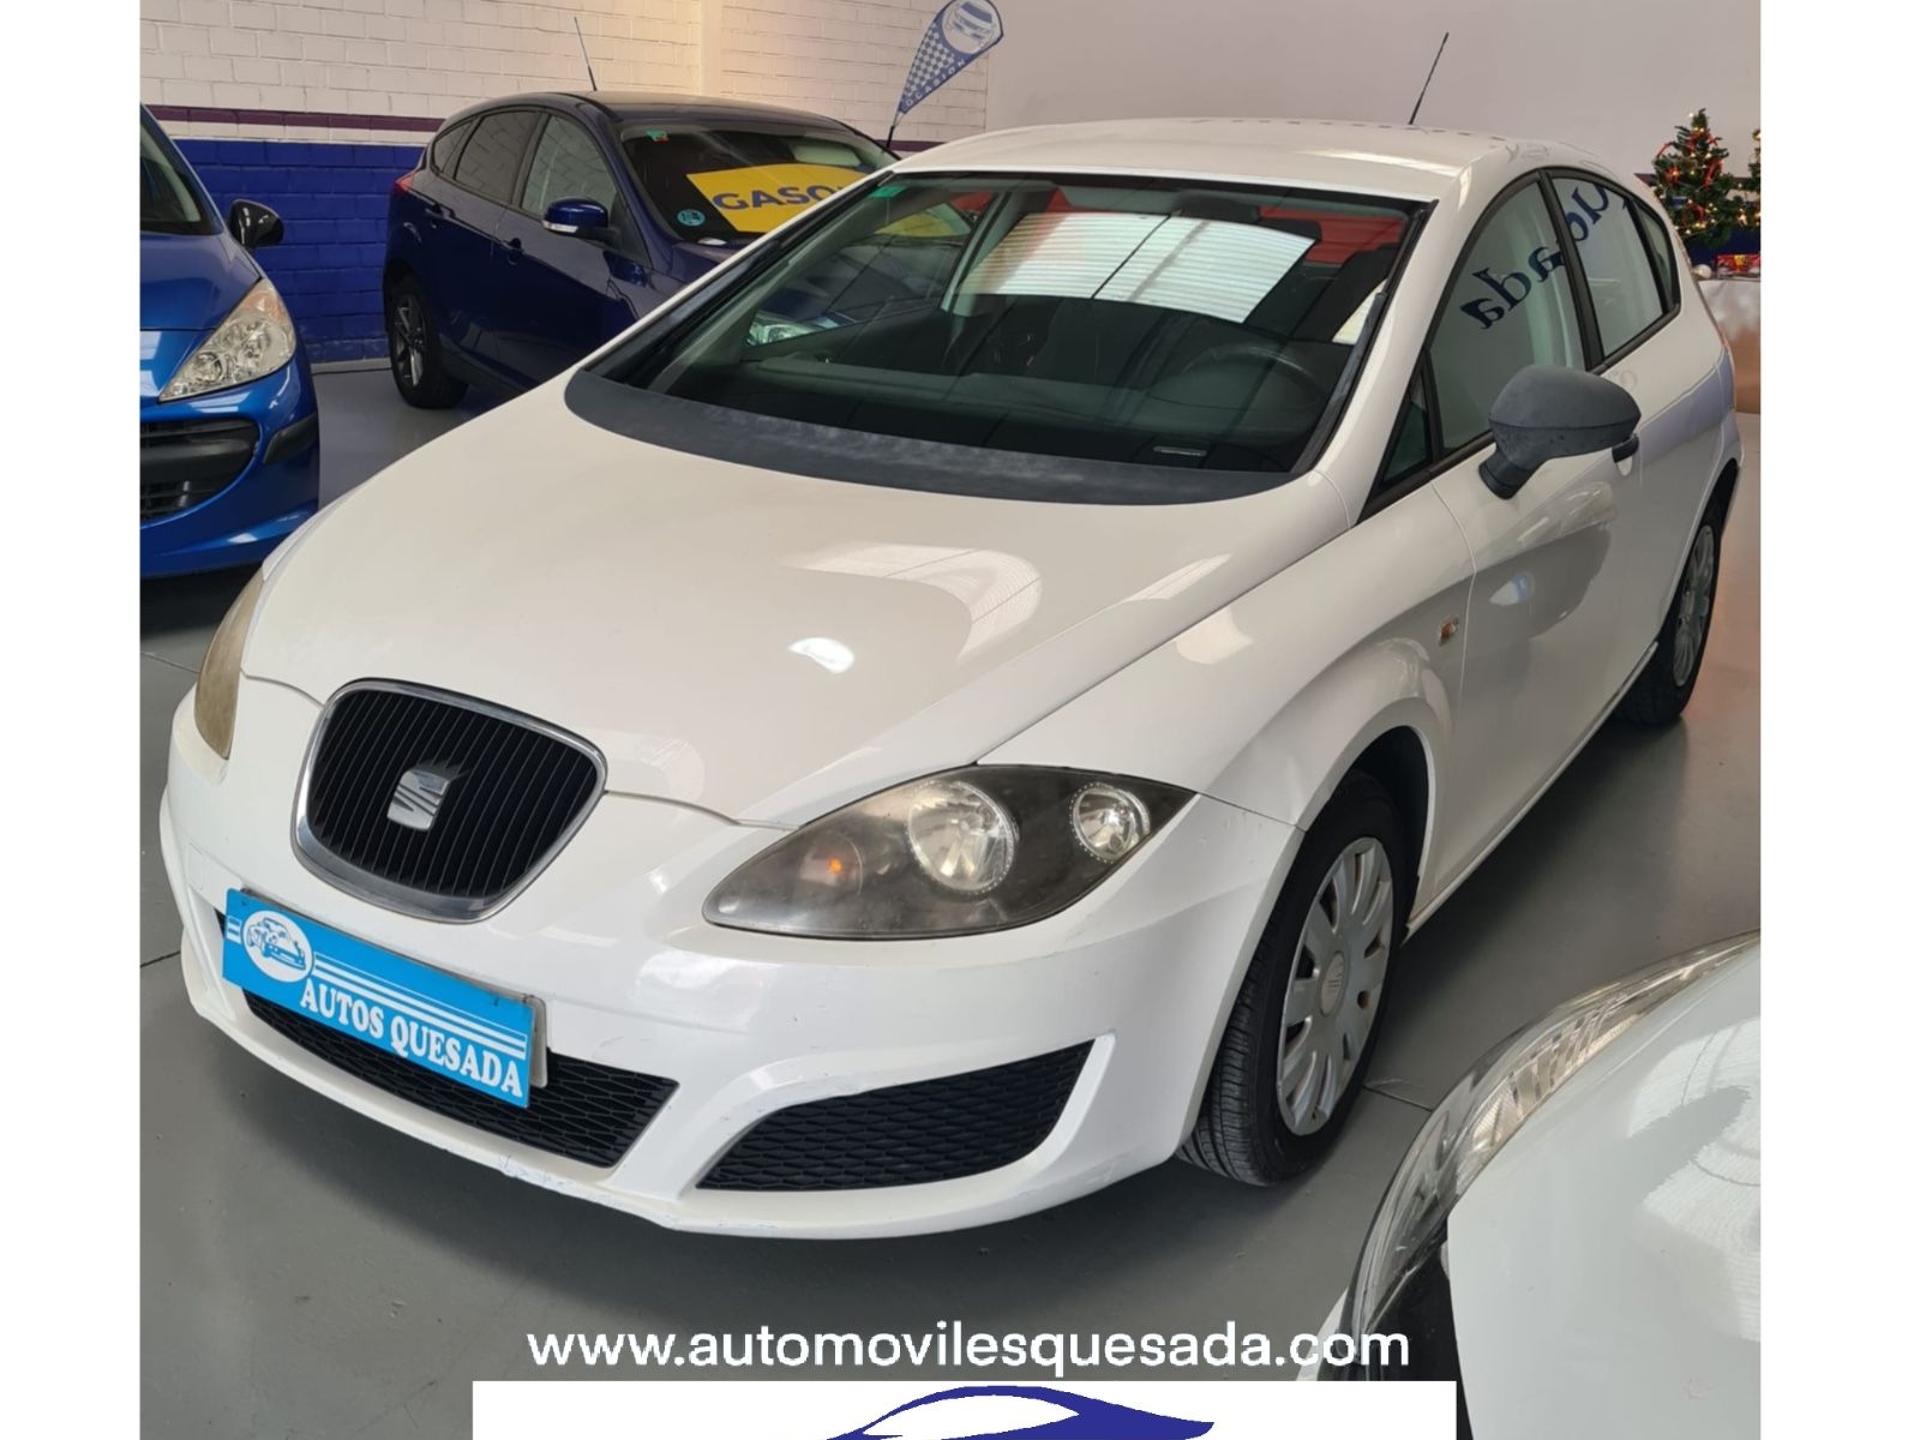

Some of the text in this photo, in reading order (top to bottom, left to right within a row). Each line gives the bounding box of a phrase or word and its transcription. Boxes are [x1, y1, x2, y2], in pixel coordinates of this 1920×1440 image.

[712, 185, 847, 211] GASO
[300, 978, 523, 1098] AUTOS QUESADA
